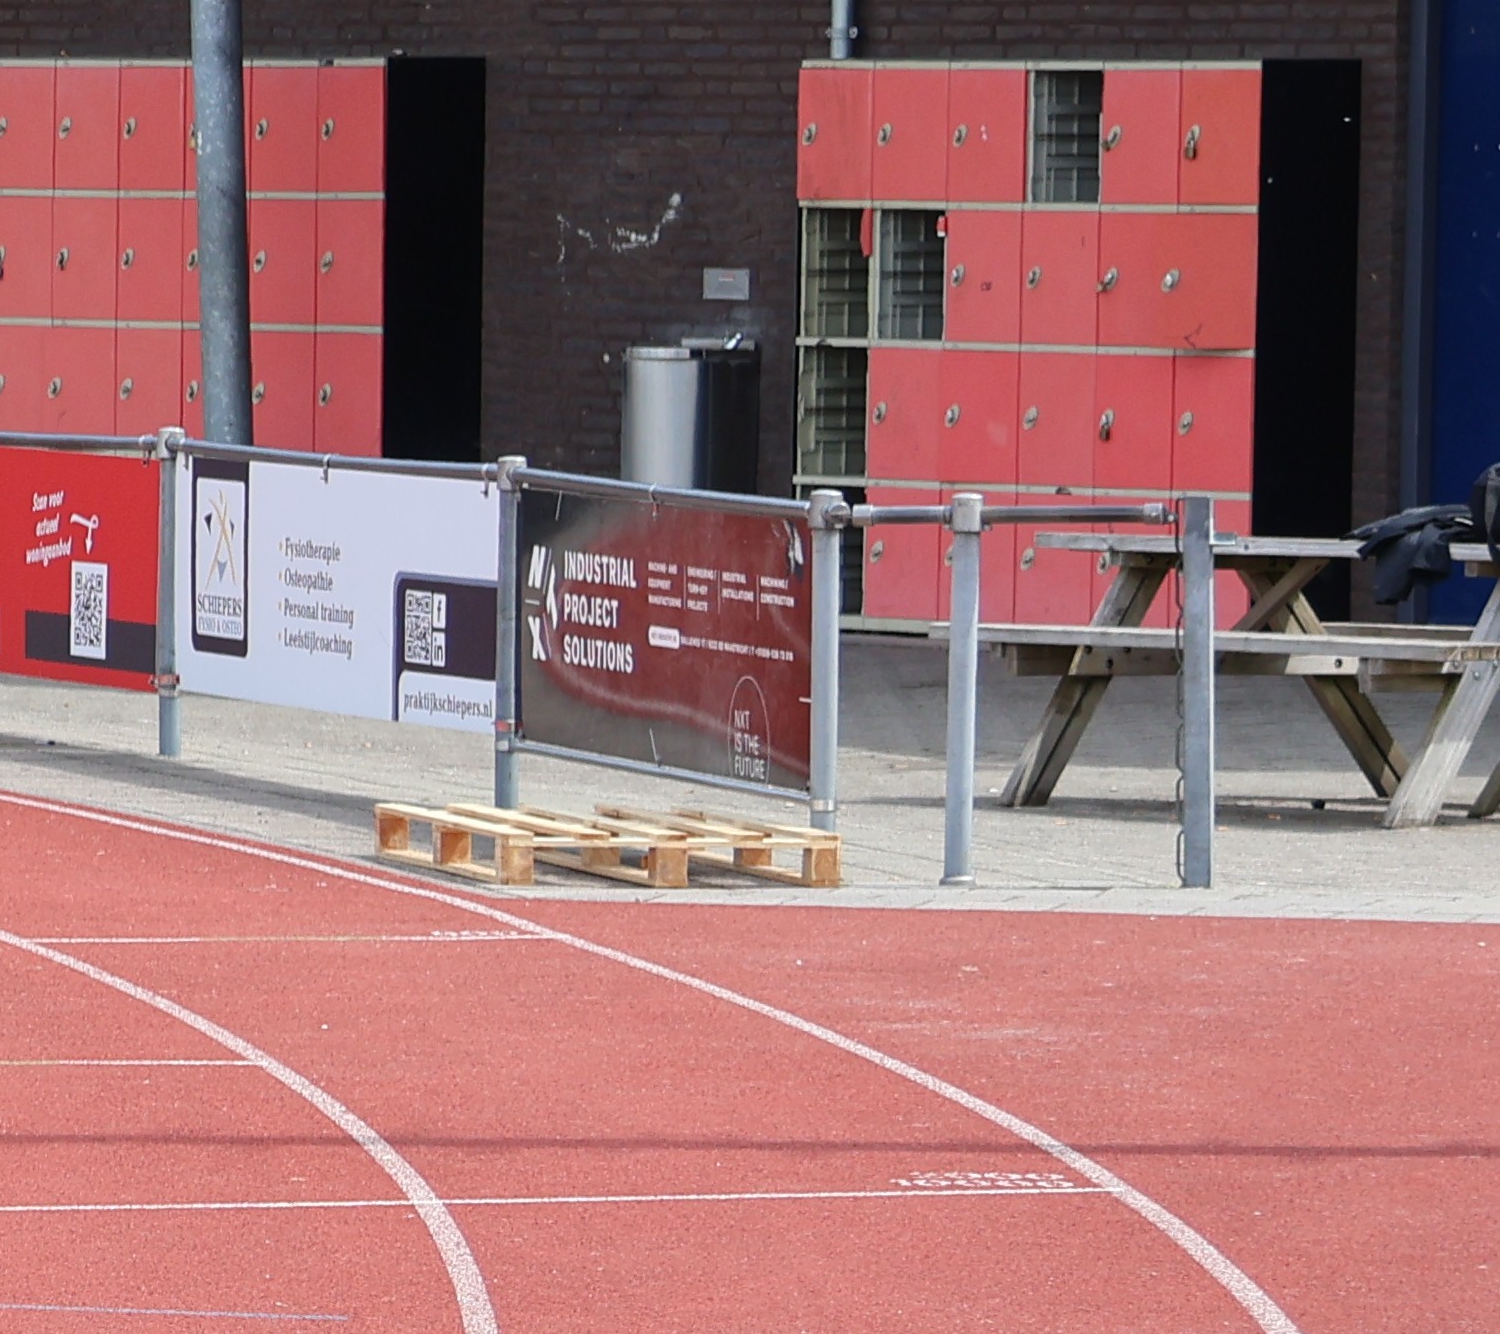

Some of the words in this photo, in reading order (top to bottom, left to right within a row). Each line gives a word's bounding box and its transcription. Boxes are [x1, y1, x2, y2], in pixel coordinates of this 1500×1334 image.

[32, 492, 47, 512] Scan
[49, 490, 64, 507] voor
[36, 513, 60, 537] actueel
[26, 536, 72, 567] woningaanbod
[285, 537, 340, 566] Fysiotherapie
[284, 567, 333, 594] Osteopathie
[564, 549, 637, 589] INDUSTRIAL
[198, 593, 243, 617] SCHIEPERS
[284, 597, 319, 620] Personal
[321, 603, 354, 629] training
[564, 593, 619, 628] PROJECT
[284, 627, 353, 661] Leefstijlcoaching
[564, 634, 633, 674] SOLUTIONS
[404, 691, 493, 720] praktijkschiepers.nl
[734, 709, 750, 730] NXT
[734, 732, 743, 752] IS
[744, 733, 760, 755] THE
[735, 754, 765, 779] FUTURE
